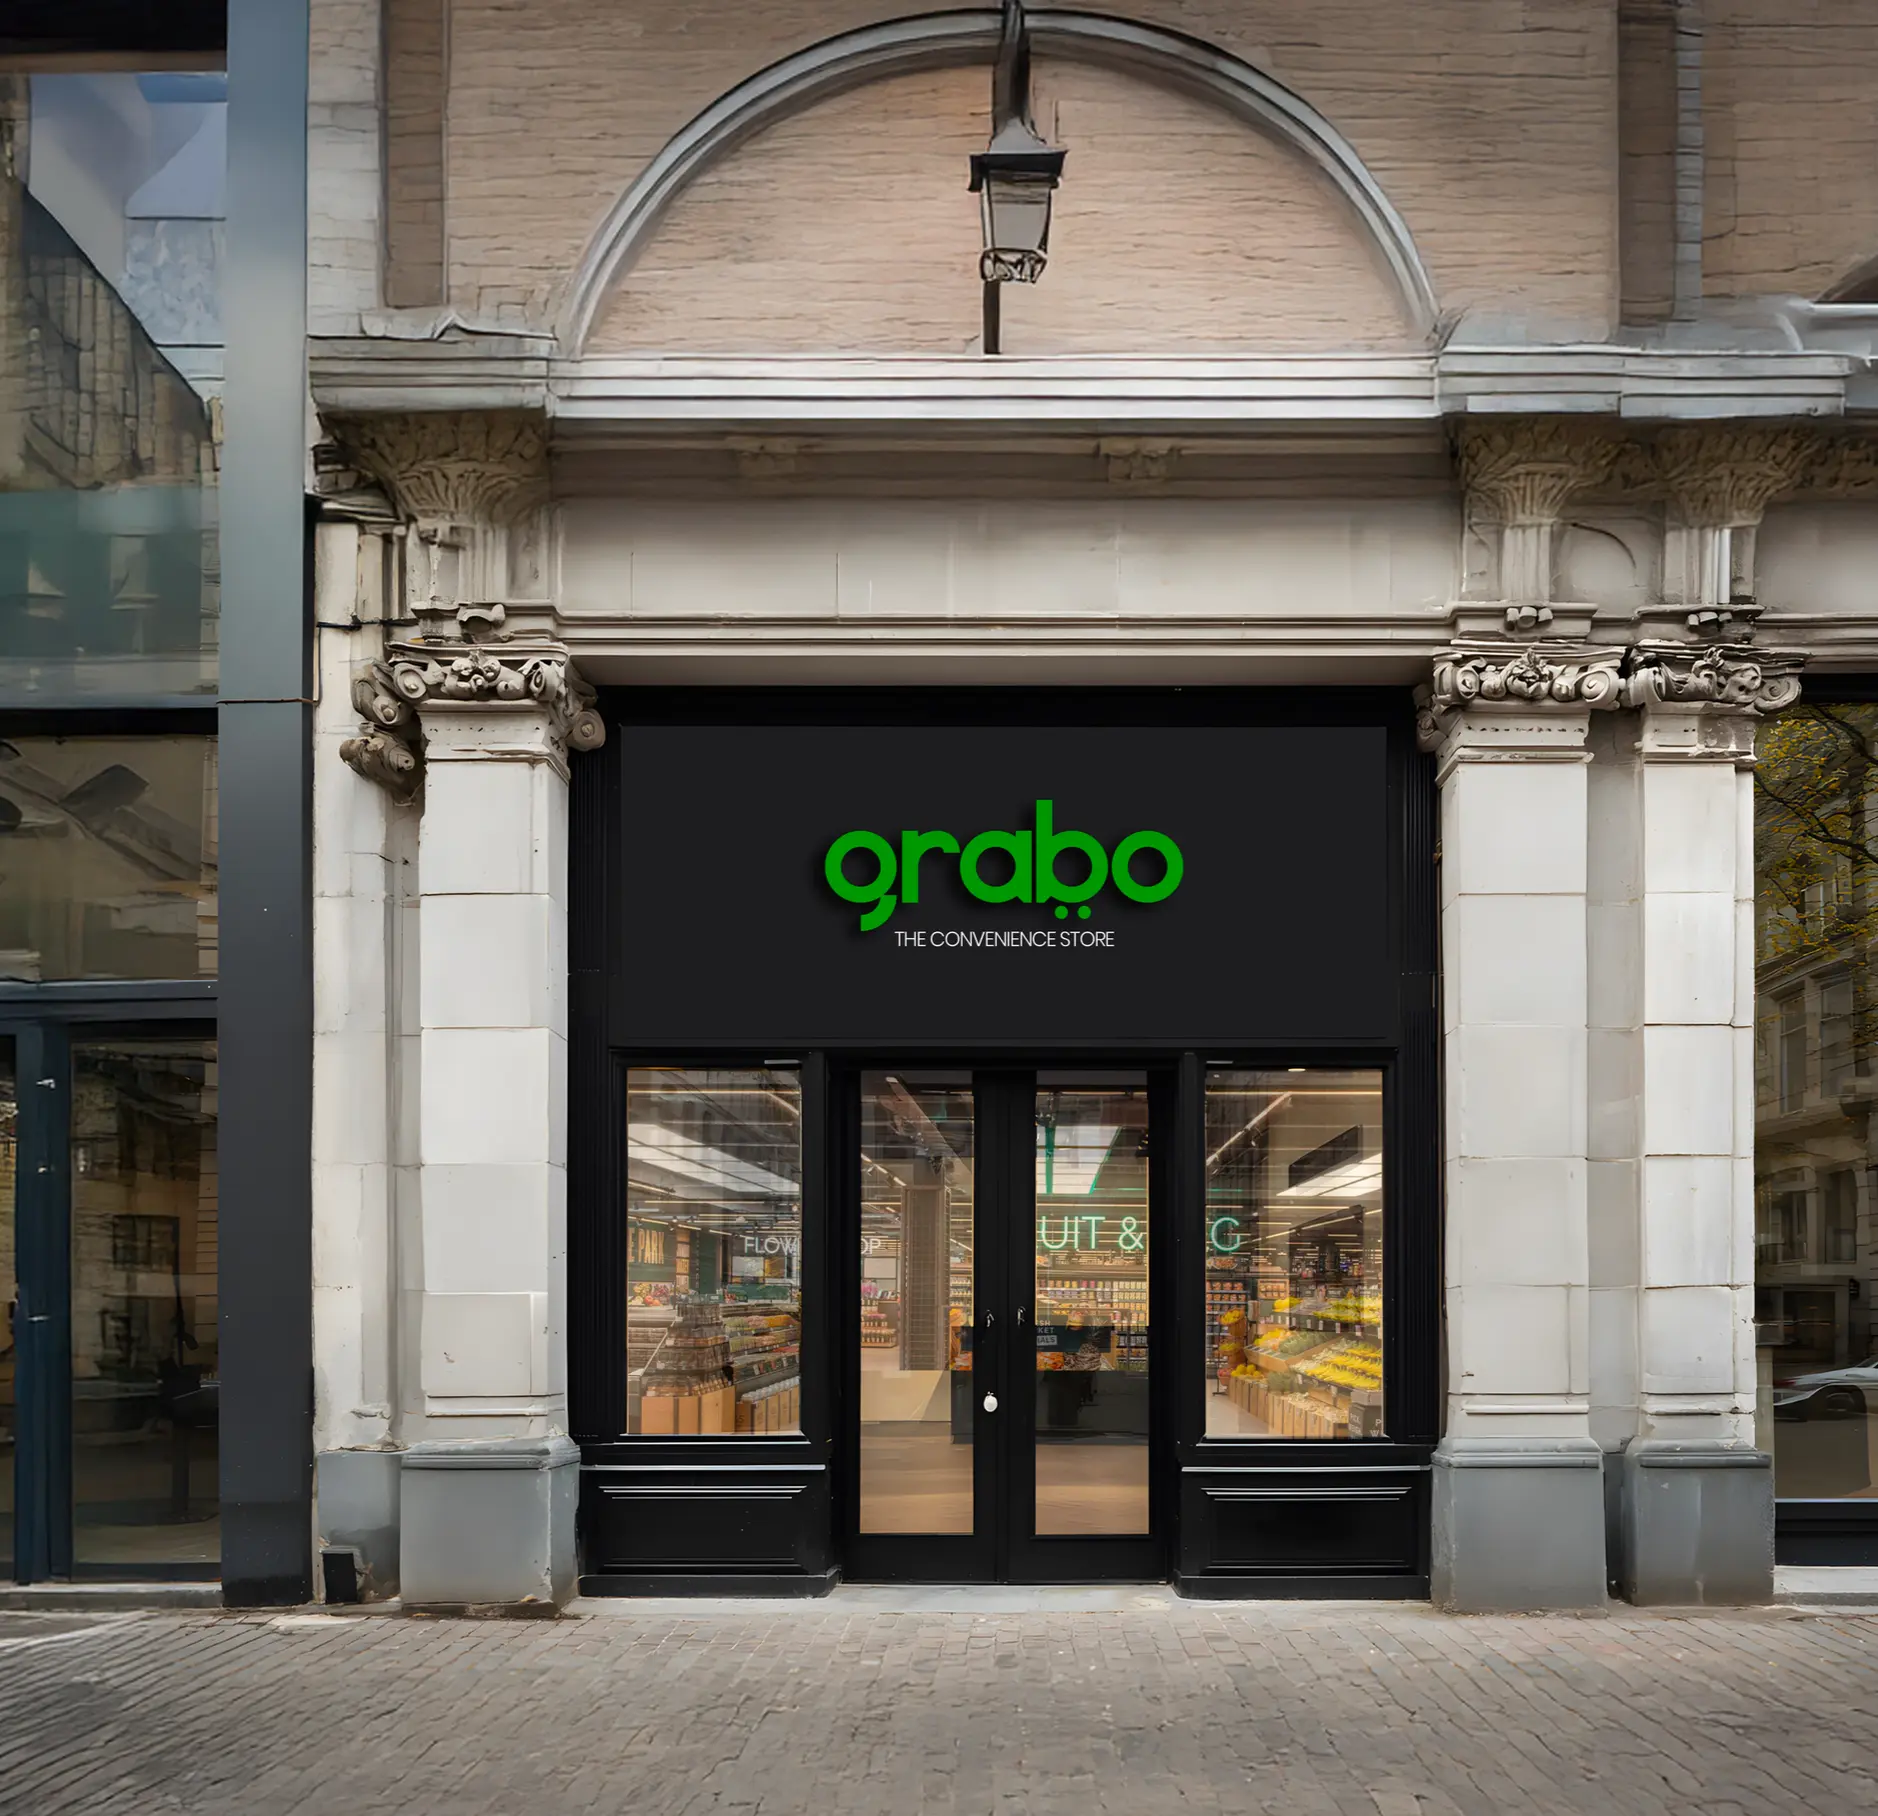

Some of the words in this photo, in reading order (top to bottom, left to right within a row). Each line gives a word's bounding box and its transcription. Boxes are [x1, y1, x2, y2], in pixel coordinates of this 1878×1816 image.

[825, 799, 1184, 931] grabo
[894, 931, 926, 947] THE
[930, 931, 1056, 947] CONVENIENCE
[1060, 931, 1115, 947] STORE
[638, 1228, 664, 1264] PARK
[1118, 1216, 1144, 1250] &
